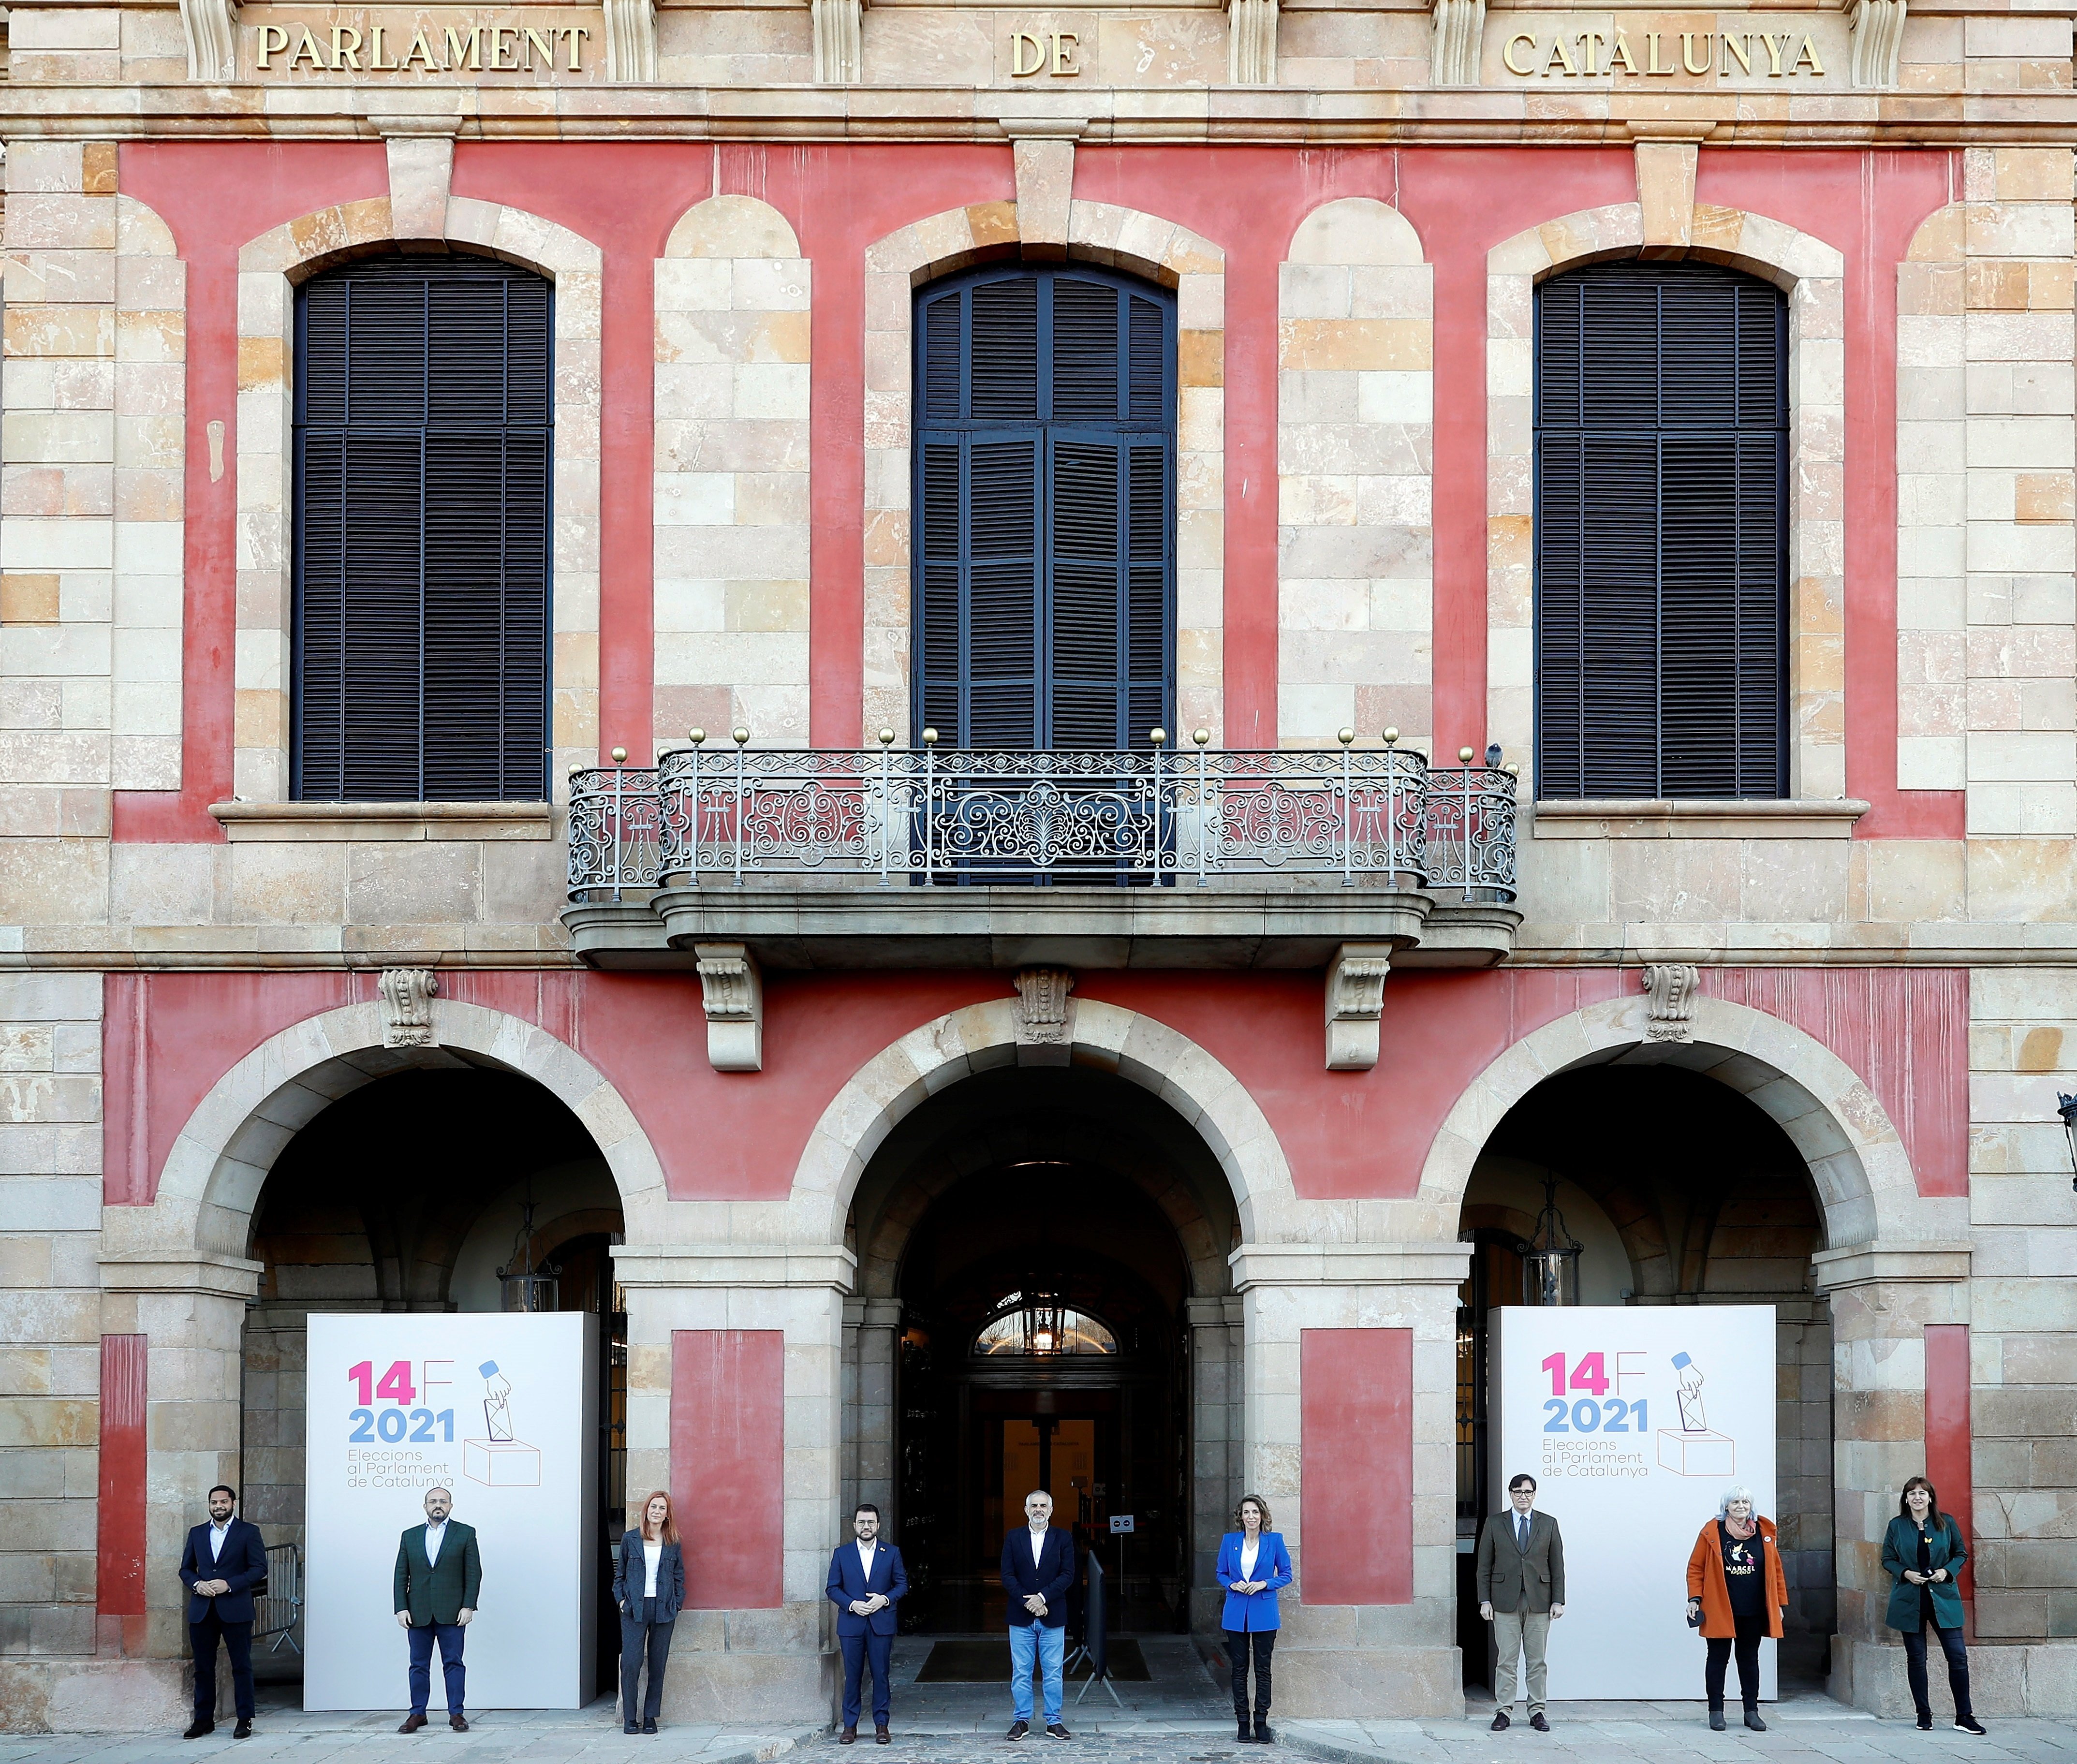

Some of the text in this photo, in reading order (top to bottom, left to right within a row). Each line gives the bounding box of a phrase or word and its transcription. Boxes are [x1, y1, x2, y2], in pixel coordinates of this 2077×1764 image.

[256, 25, 1825, 77] PARLAMENT DE CATALUNYA
[1542, 1352, 1647, 1396] 14F
[349, 1361, 454, 1405] 14F
[1543, 1398, 1648, 1432] 2021
[349, 1408, 454, 1443] 2021
[1543, 1439, 1617, 1451] Eleccions
[348, 1449, 422, 1461] Eleccions
[1542, 1451, 1643, 1463] al Parlament
[347, 1462, 449, 1474] al Parlament
[1543, 1464, 1648, 1478] de Catalunya
[347, 1475, 454, 1487] de Catalunya
